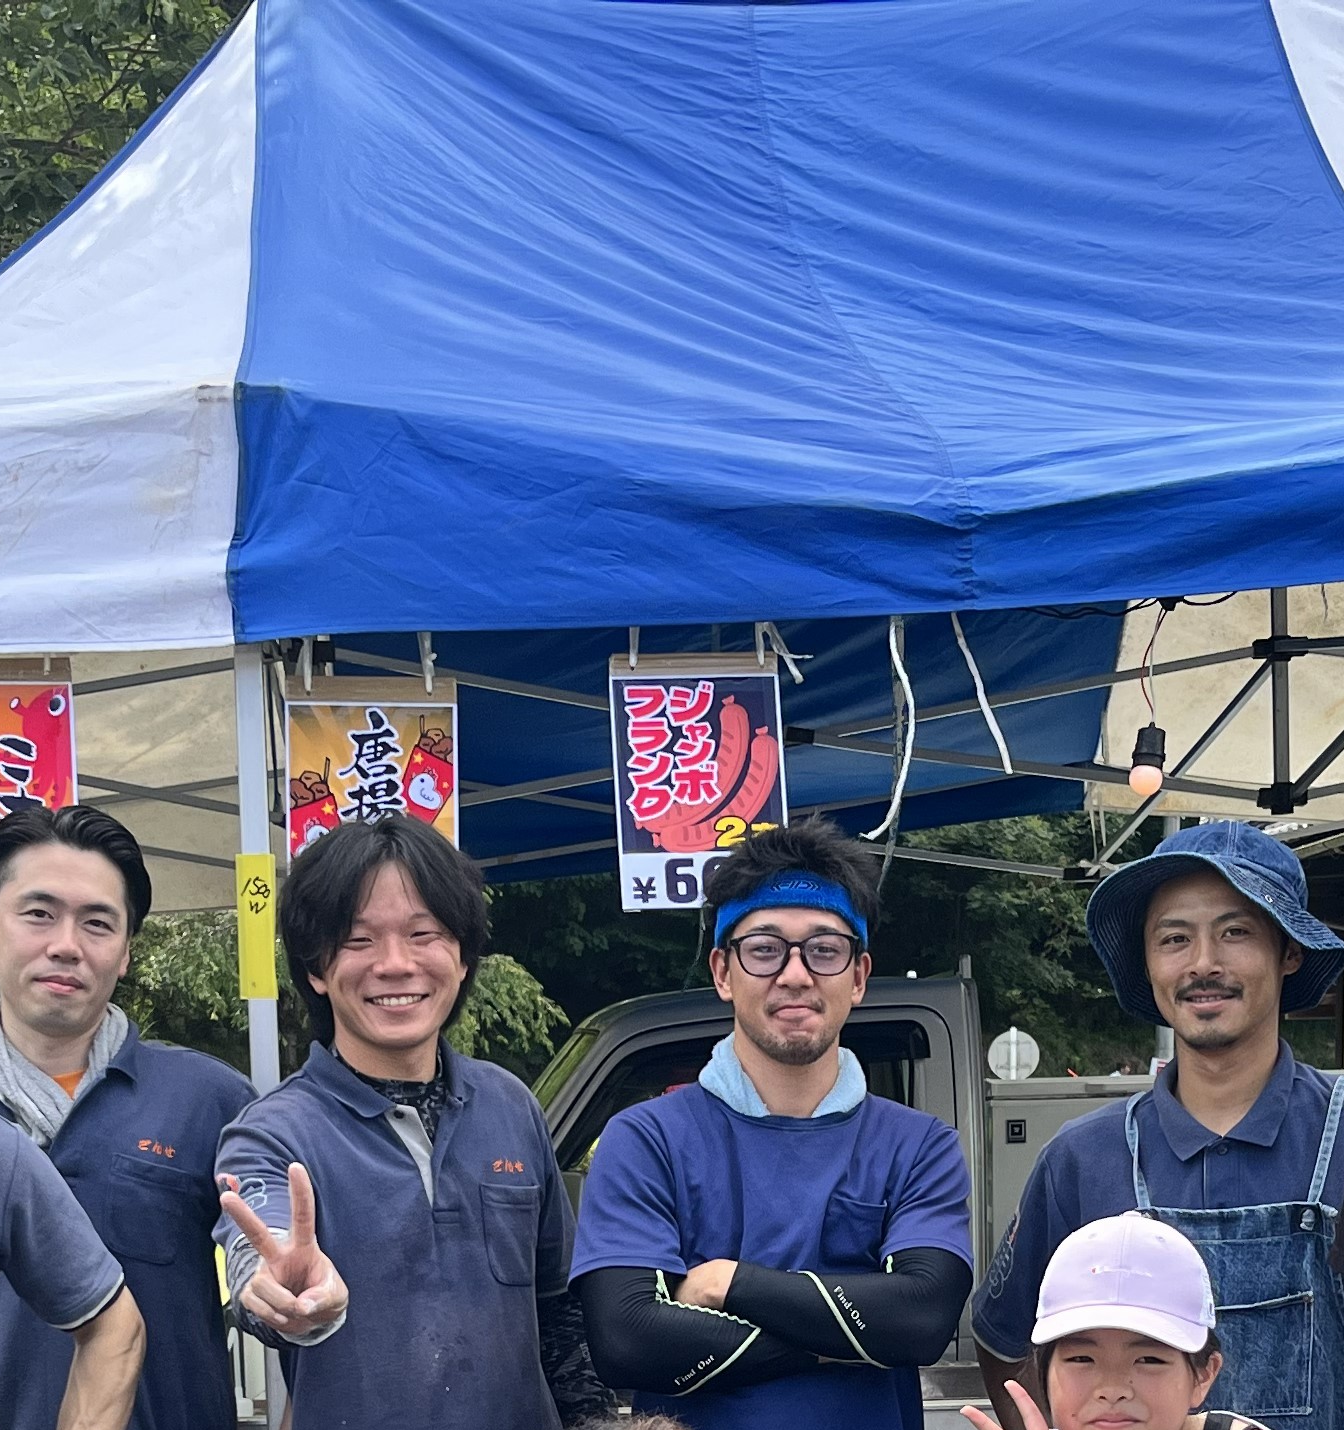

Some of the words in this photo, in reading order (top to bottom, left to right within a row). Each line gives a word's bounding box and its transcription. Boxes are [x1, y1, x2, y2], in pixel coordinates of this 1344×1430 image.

[626, 687, 674, 819] フランク
[669, 682, 720, 803] ジャンボ
